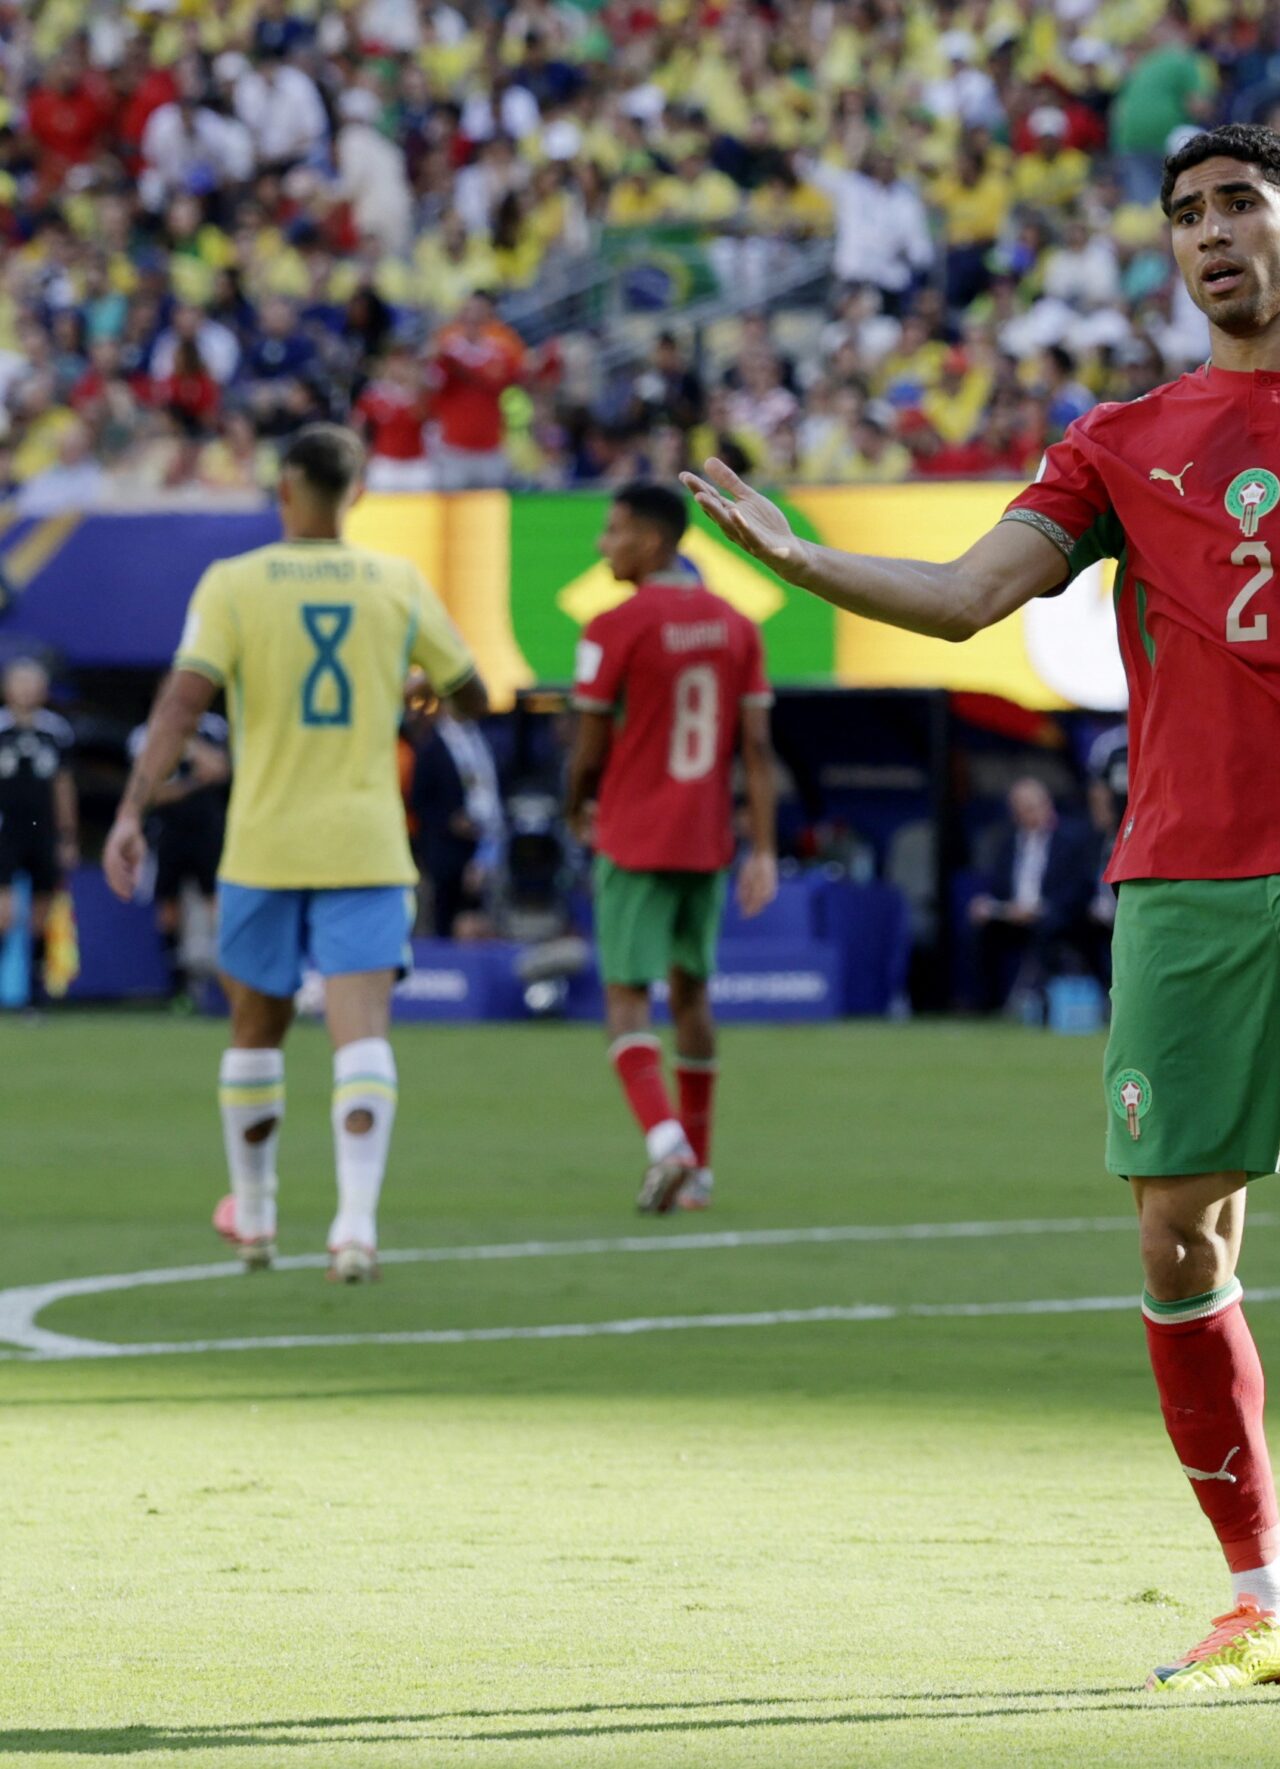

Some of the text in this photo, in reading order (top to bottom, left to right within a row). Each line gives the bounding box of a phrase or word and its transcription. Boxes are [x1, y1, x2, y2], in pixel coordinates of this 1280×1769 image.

[1226, 541, 1274, 643] 2
[302, 604, 353, 727] 8
[669, 664, 718, 783] 8
